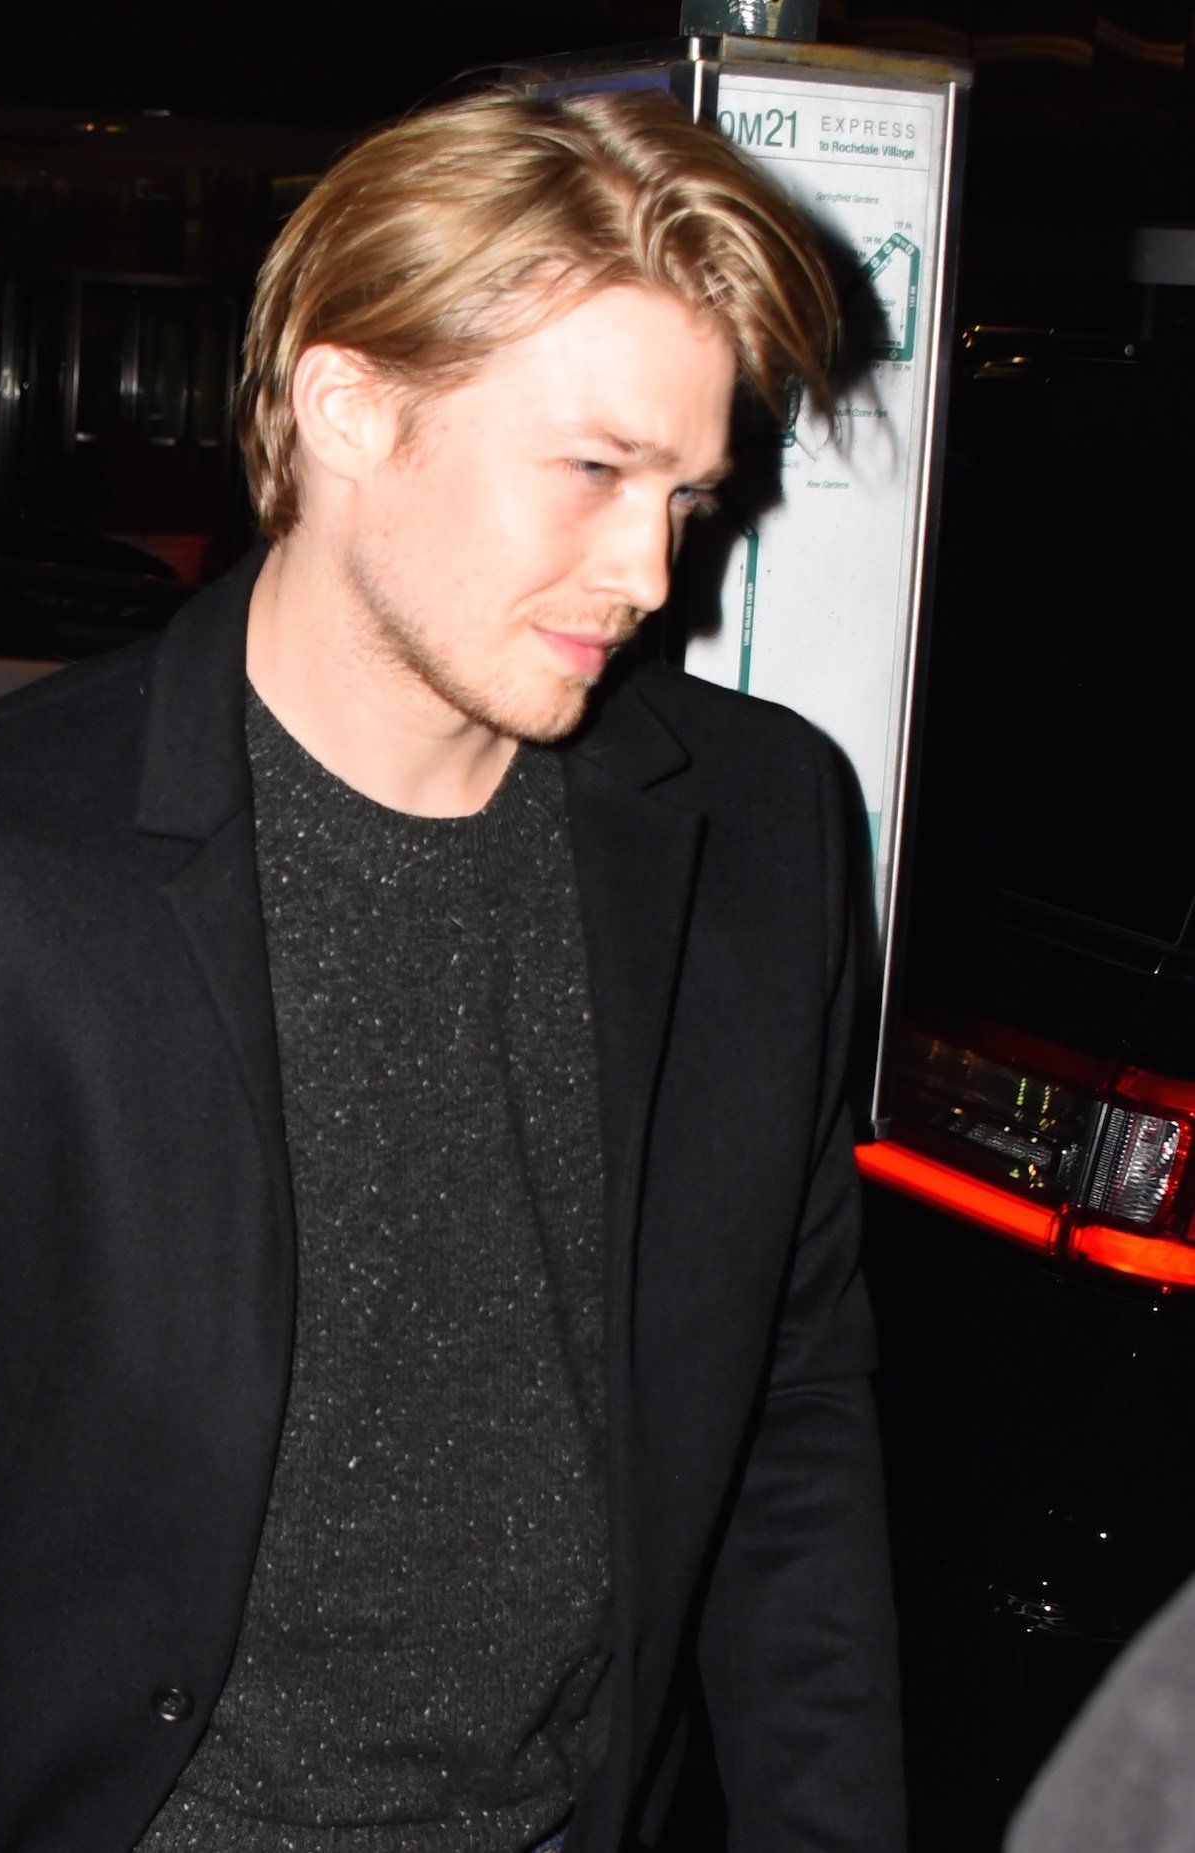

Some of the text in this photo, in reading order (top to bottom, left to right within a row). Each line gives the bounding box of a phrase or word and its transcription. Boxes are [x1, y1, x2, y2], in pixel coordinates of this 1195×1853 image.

[820, 116, 916, 139] EXPRESS
[819, 140, 915, 160] to Rochdale Village
[815, 191, 880, 205] Springfield Gardens
[807, 480, 849, 490] Kew Gardens
[744, 606, 752, 628] ISLAND
[743, 629, 751, 646] LONG
